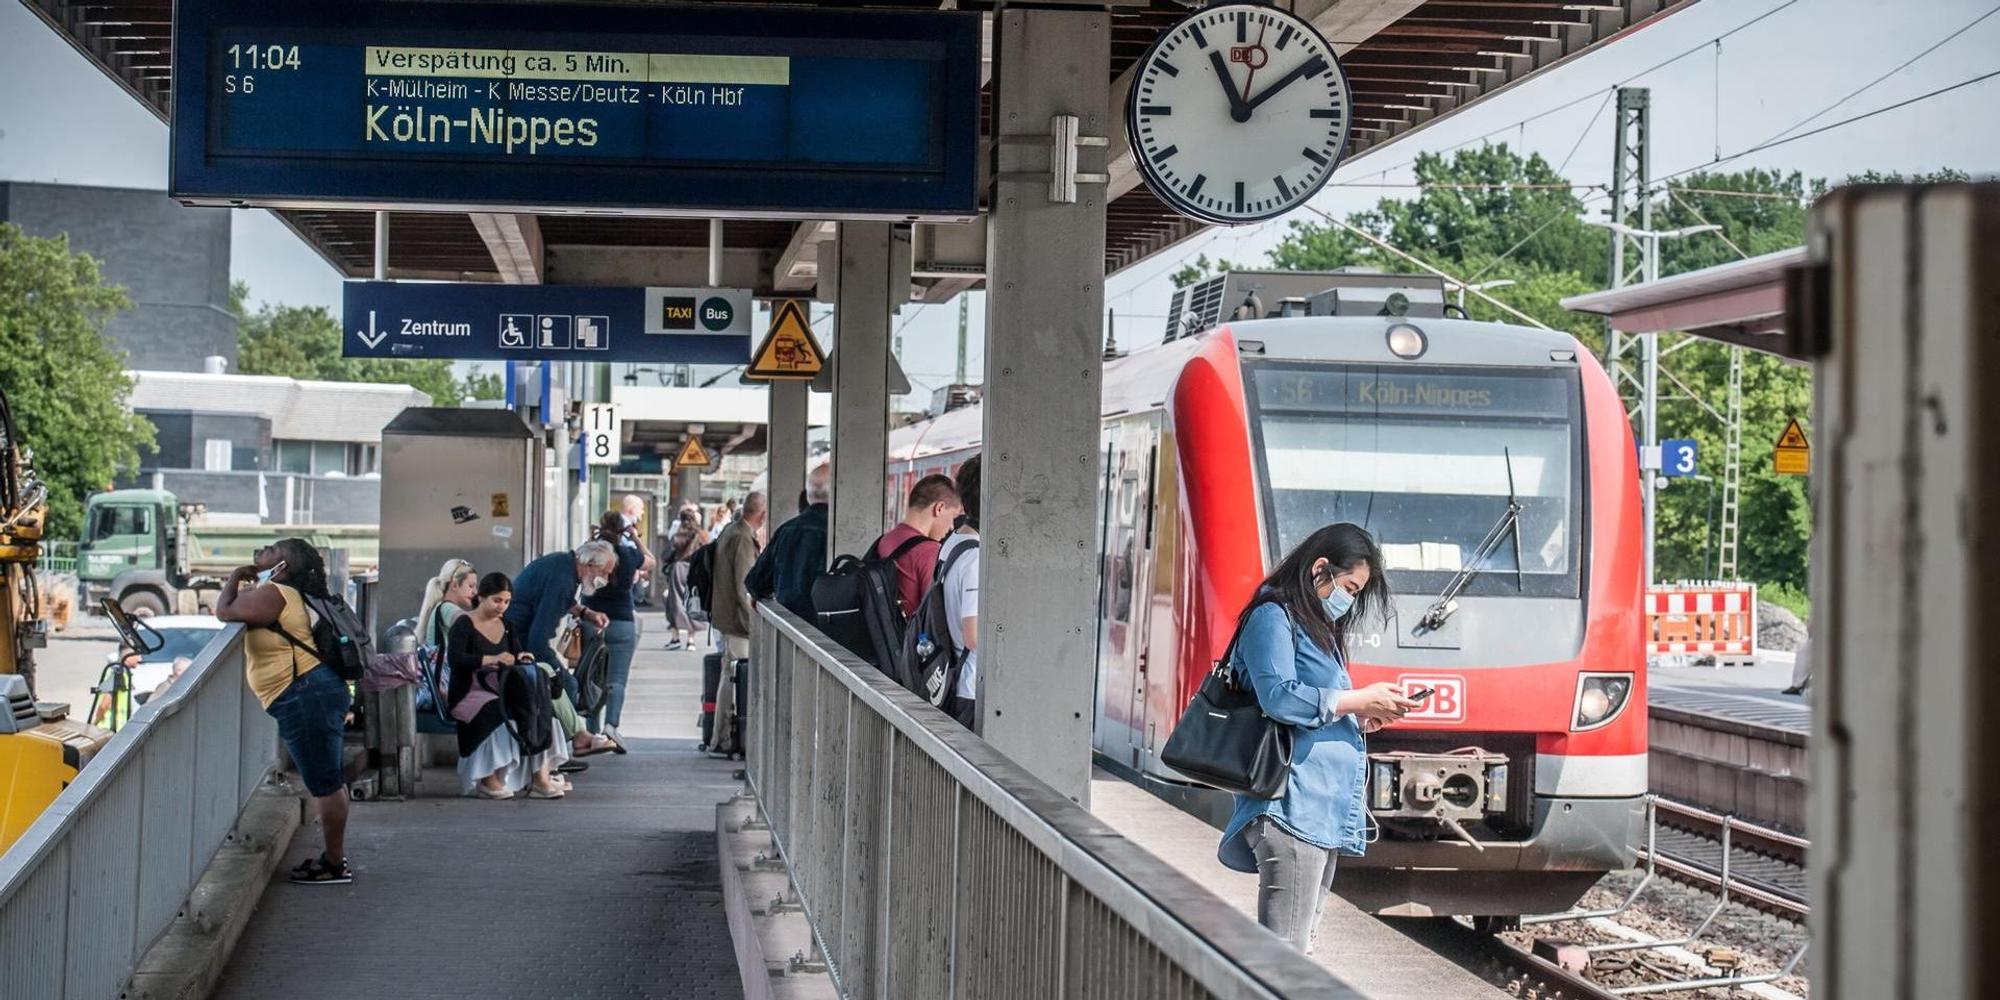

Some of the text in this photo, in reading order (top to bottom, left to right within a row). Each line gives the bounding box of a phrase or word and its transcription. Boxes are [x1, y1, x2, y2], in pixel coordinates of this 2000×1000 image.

[228, 44, 301, 70] 11:04
[376, 49, 631, 75] Verspätung ca. 5 Min.
[225, 74, 255, 94] S 6
[367, 78, 468, 99] K-Mülheim
[489, 82, 501, 100] K
[509, 82, 640, 104] Messe/Deutz
[662, 86, 706, 105] Köln
[712, 87, 745, 107] Hbf
[366, 104, 599, 155] Köln-Nippes
[666, 306, 693, 319] TAXI
[706, 307, 729, 320] Bus
[400, 318, 471, 337] Zentrum
[1359, 379, 1492, 409] Köln-Nippes
[591, 406, 614, 431] 11
[594, 433, 610, 458] 8
[1676, 446, 1695, 473] 3
[926, 665, 943, 693] NIKE
[1407, 683, 1457, 714] DB
